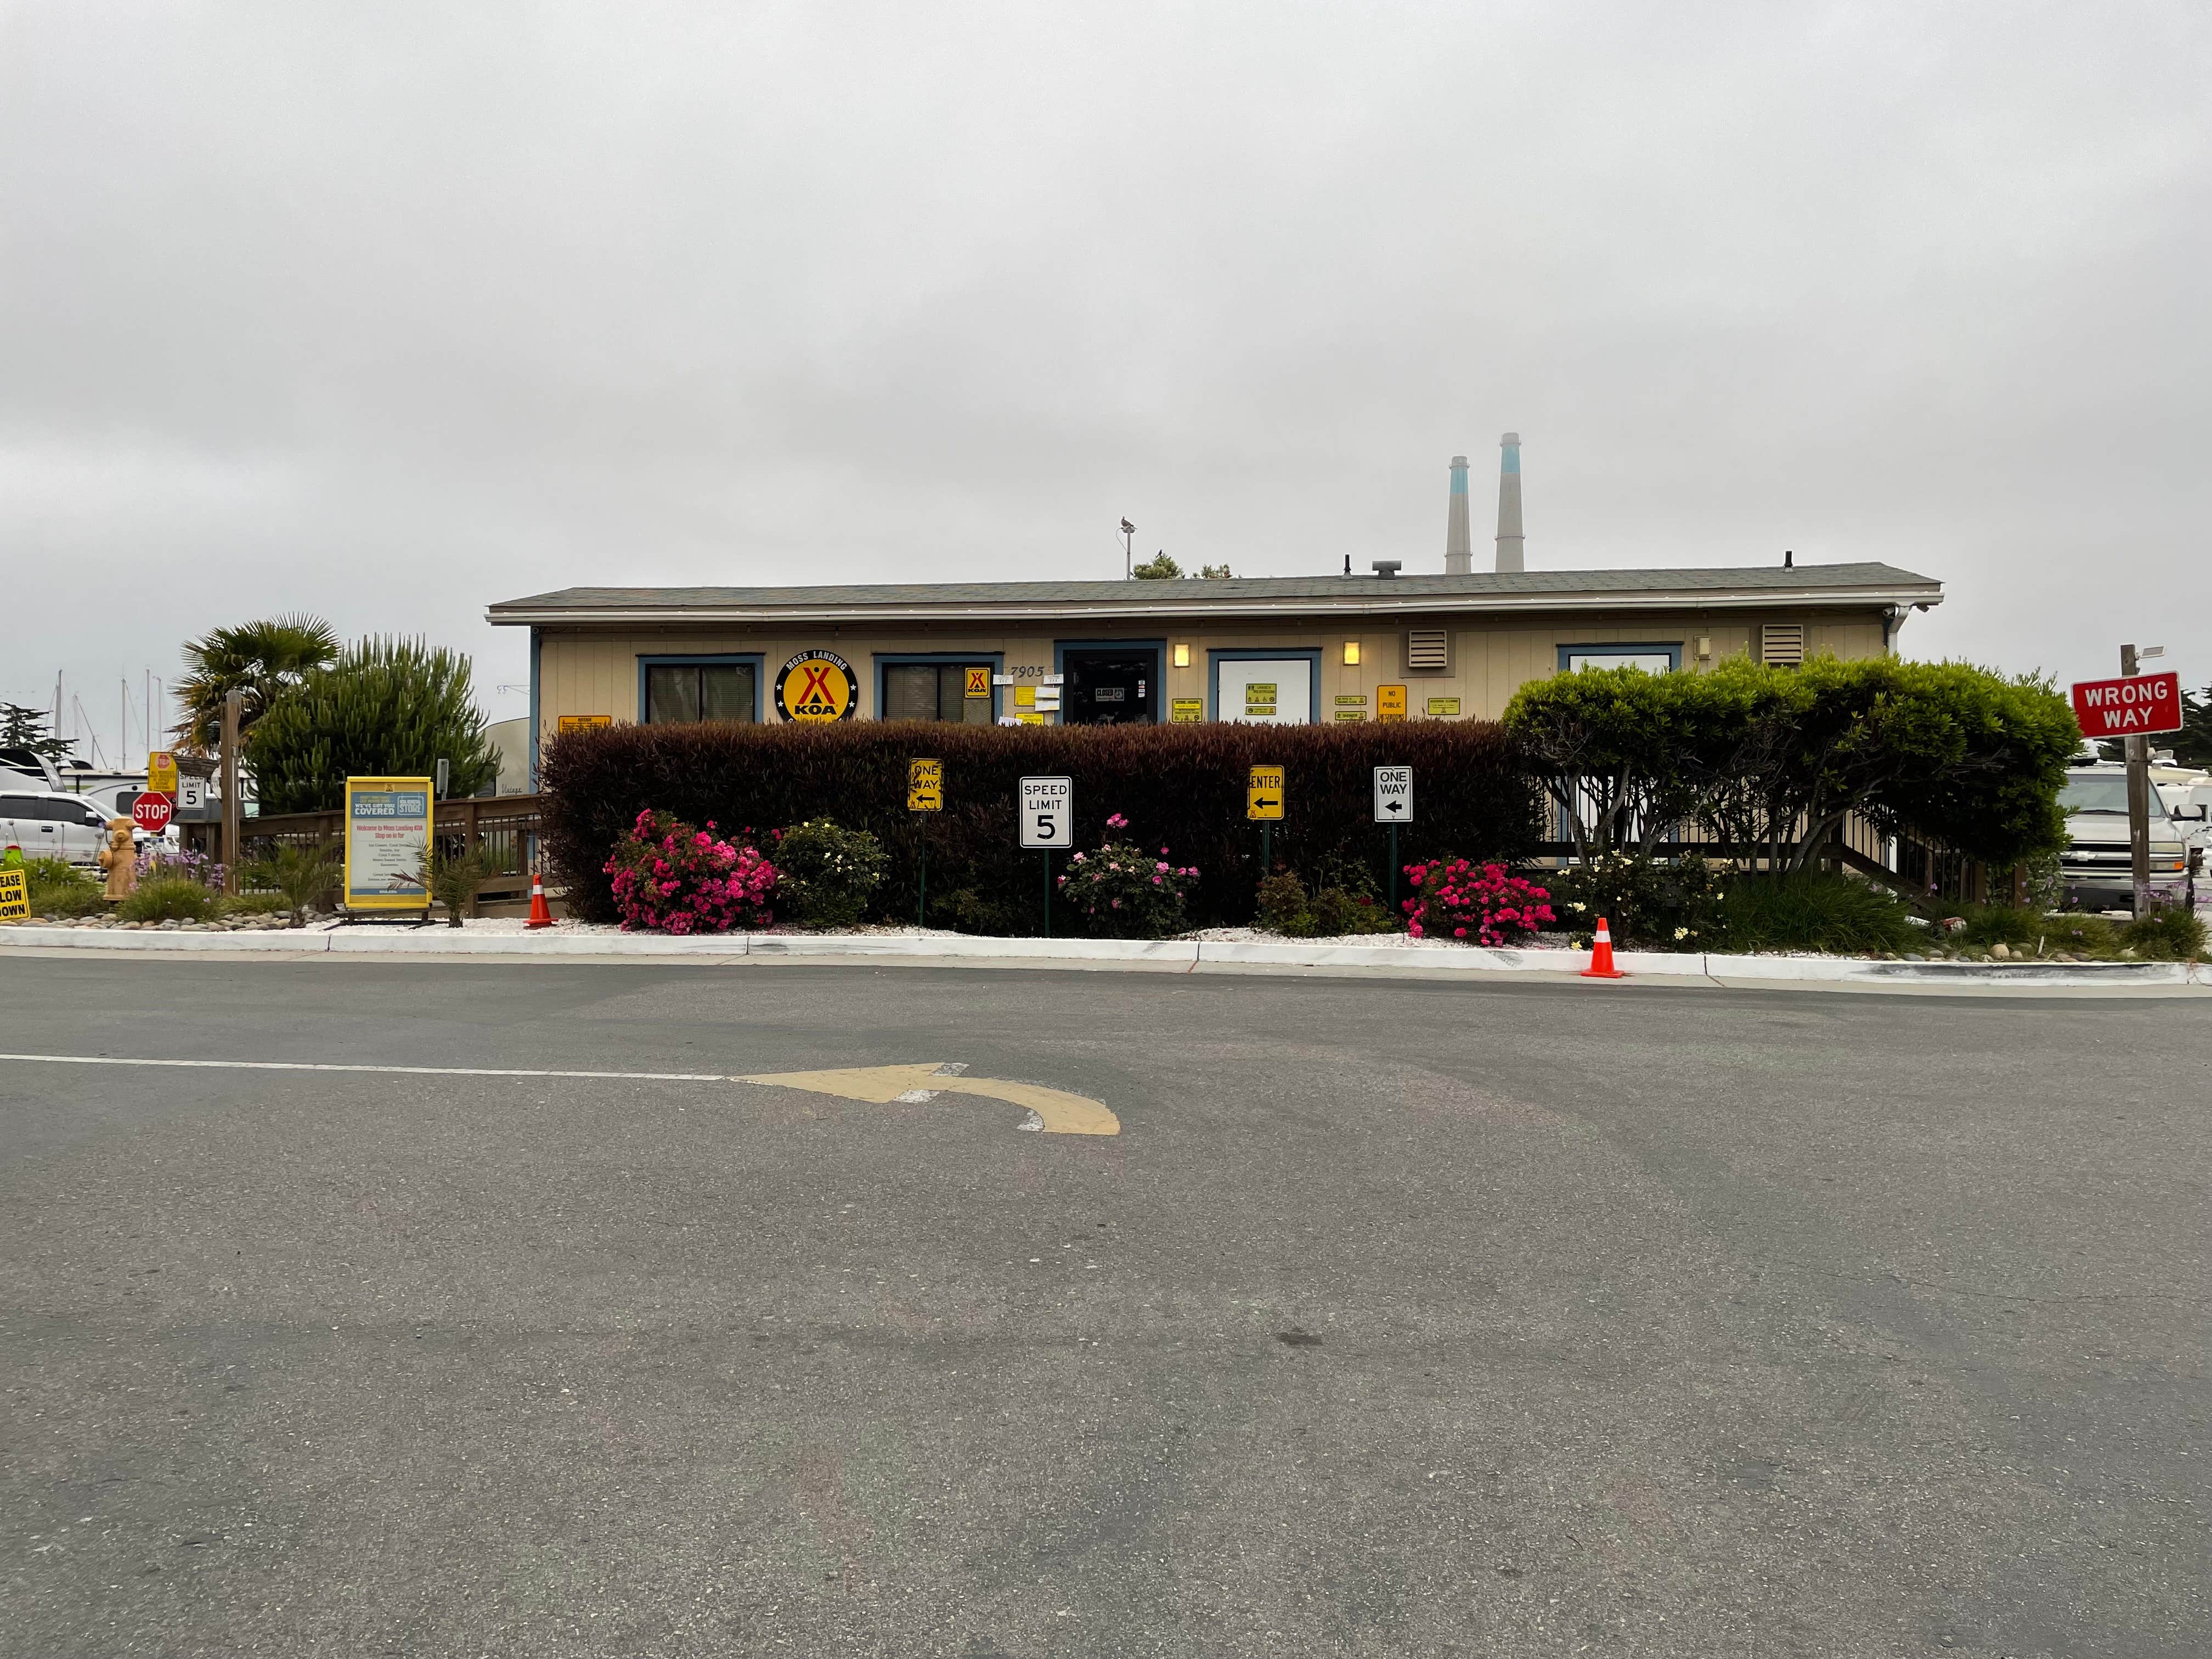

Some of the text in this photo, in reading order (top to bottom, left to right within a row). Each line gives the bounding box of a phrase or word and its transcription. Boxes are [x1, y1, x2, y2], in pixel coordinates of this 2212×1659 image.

[786, 651, 848, 671] MOSS LANDING
[1011, 666, 1045, 678] 7905
[2085, 681, 2167, 707] WRONG
[794, 704, 837, 715] KOA
[2103, 706, 2153, 729] WAY
[915, 766, 939, 775] ONE
[1251, 776, 1280, 788] ENTER
[1380, 772, 1407, 782] ONE
[913, 780, 938, 789] WAY
[1024, 785, 1067, 795] SPEED
[1380, 784, 1407, 794] WAY
[186, 791, 197, 805] 5
[400, 804, 422, 813] STORE
[1029, 800, 1062, 810] LIMIT
[135, 804, 168, 819] STOP
[1037, 815, 1056, 840] 5
[0, 874, 21, 888] EASE
[0, 889, 21, 903] LOW
[0, 904, 25, 917] OWN
